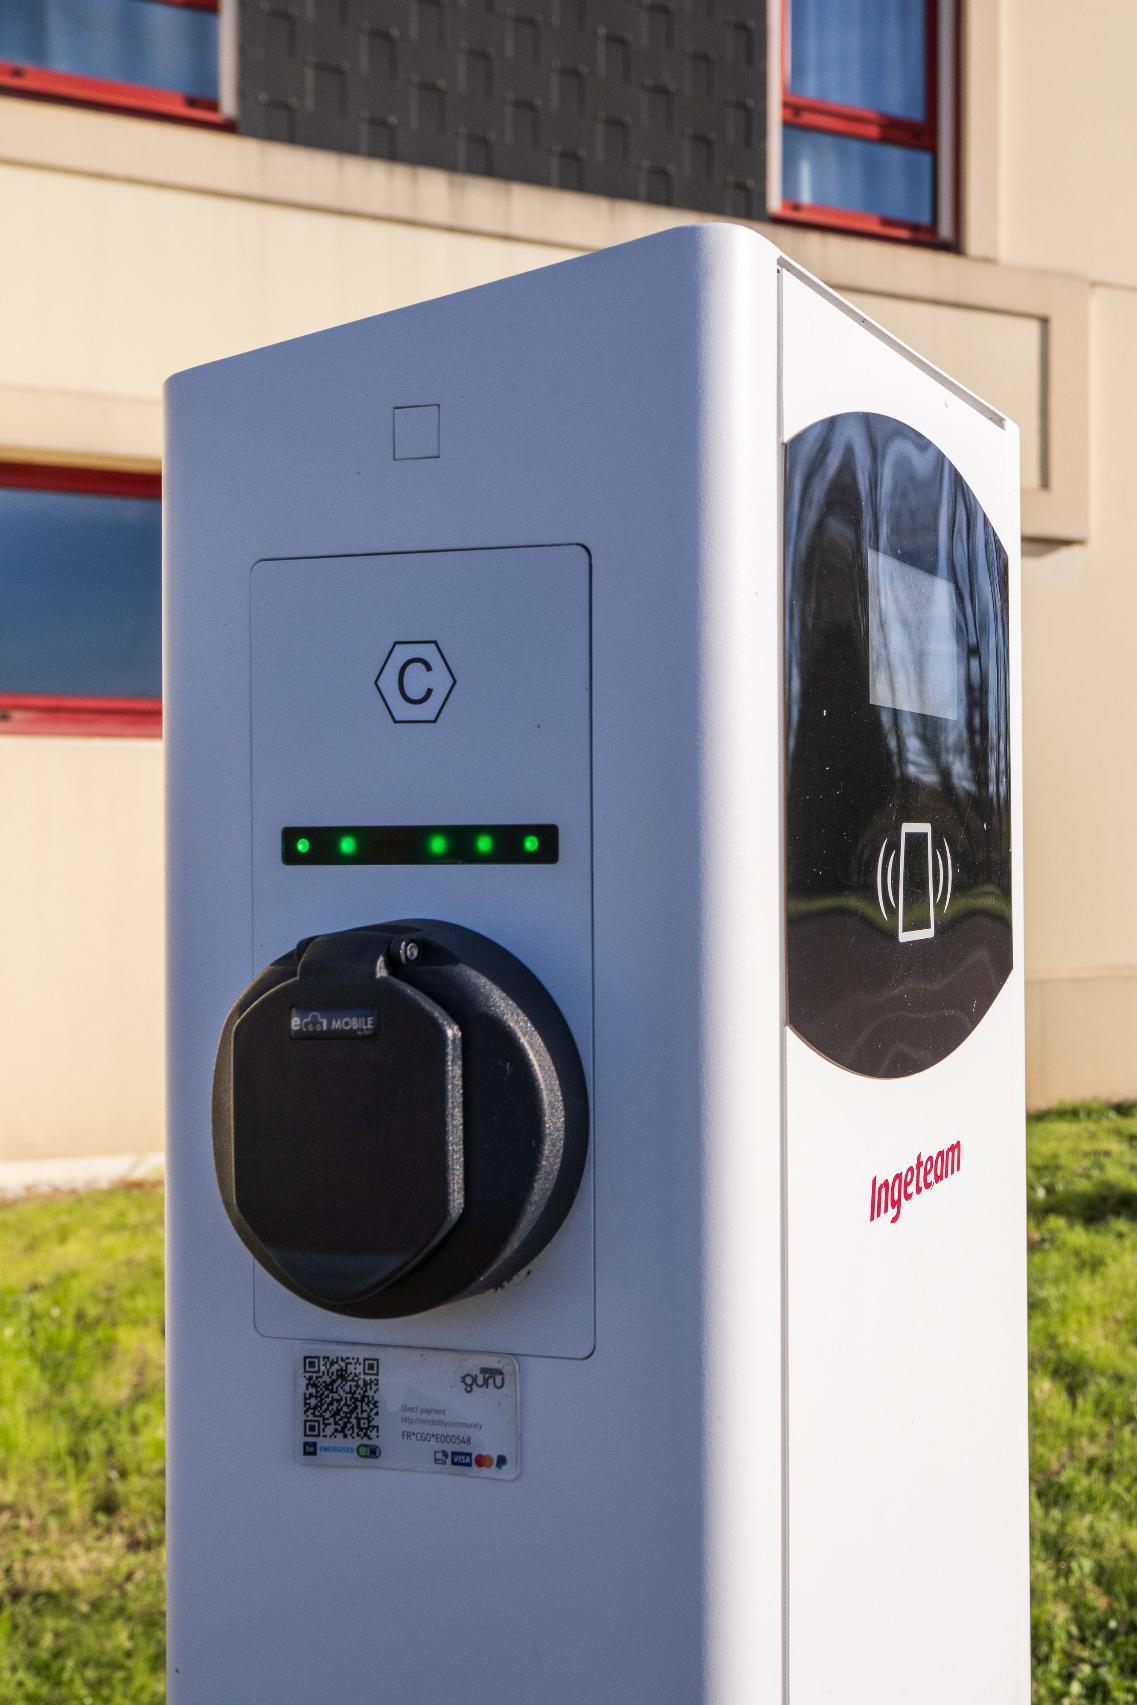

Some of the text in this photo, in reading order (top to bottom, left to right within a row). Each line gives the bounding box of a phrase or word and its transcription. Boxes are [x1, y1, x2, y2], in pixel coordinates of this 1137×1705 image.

[397, 657, 434, 705] C
[331, 1016, 375, 1029] MOBILE
[869, 1140, 961, 1224] Ingeteam
[453, 1454, 471, 1465] VISA
